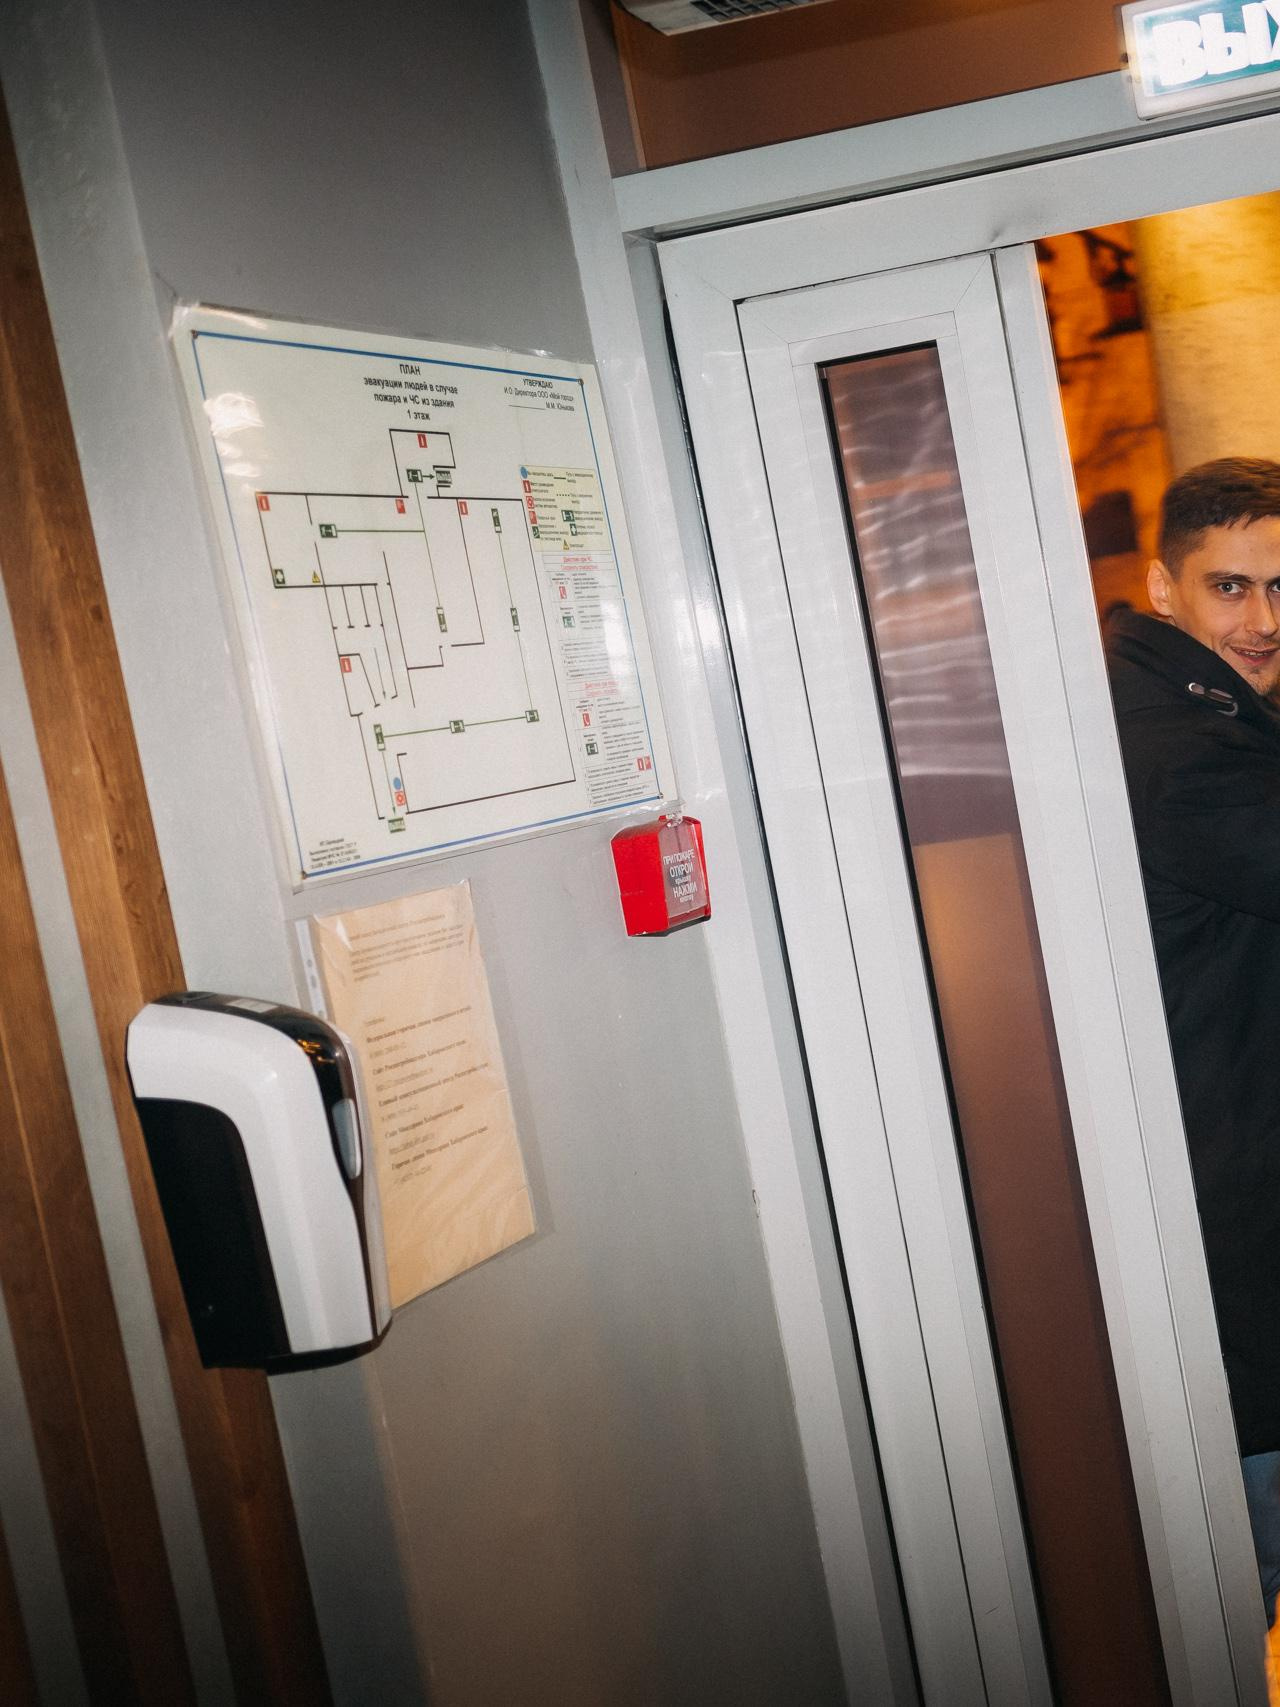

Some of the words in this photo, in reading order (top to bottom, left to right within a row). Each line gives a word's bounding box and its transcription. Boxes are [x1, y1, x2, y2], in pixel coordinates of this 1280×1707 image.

[399, 364, 421, 376] ПЛАН
[363, 377, 403, 390] эвакуации
[404, 381, 428, 392] людей
[435, 384, 458, 395] случае
[523, 378, 554, 389] УТВЕРЖДАЮ
[373, 393, 401, 406] пожара
[402, 396, 408, 404] и
[408, 394, 420, 405] ЧС
[421, 398, 430, 406] из
[431, 398, 455, 408] здания
[407, 409, 411, 419] 1
[413, 411, 431, 421] этаж
[663, 855, 674, 865] ПРИ
